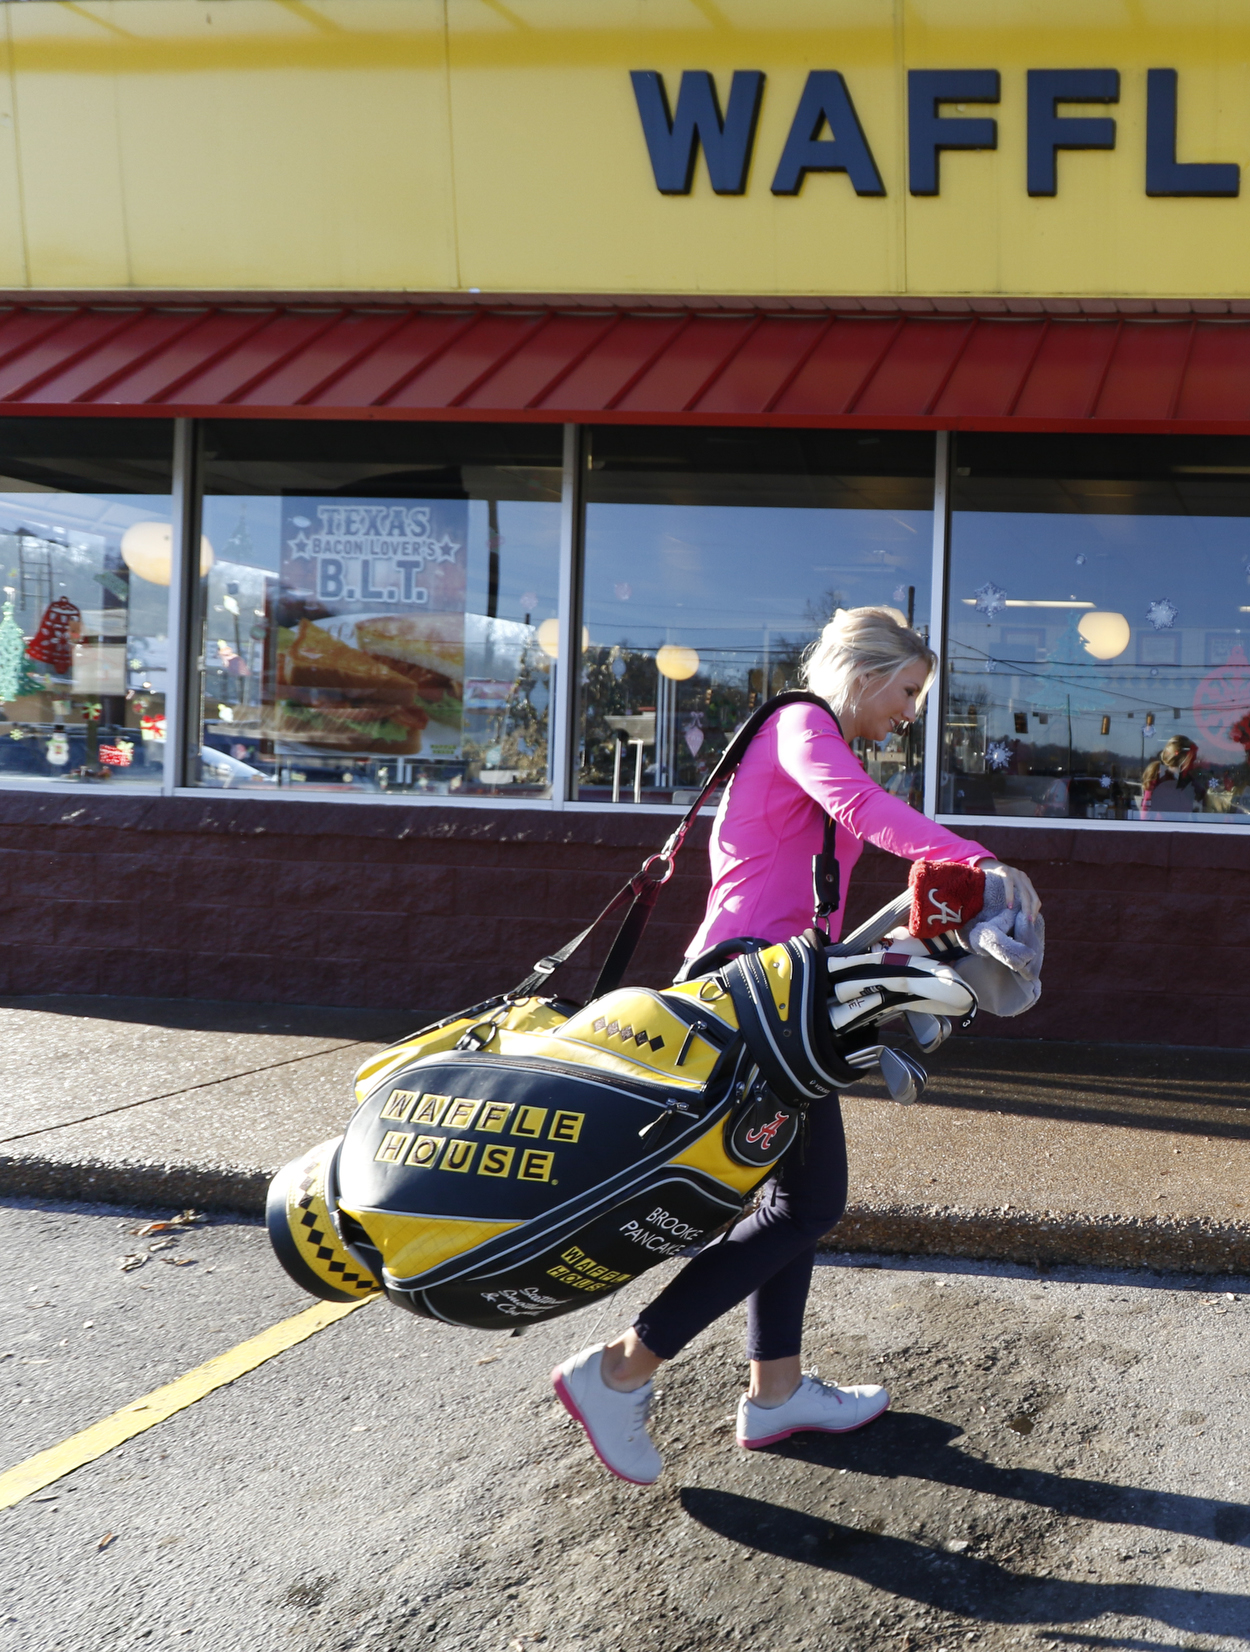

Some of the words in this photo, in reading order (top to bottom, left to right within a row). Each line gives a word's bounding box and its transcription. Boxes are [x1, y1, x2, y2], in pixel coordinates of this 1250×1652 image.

[317, 505, 431, 537] TEXAS
[312, 538, 364, 555] BACON
[369, 538, 436, 557] LOVER'S
[318, 557, 427, 602] B.L.T.
[383, 1090, 583, 1142] WAFFLE
[377, 1132, 552, 1181] HOUSE
[619, 1220, 686, 1256] PANCAKE
[646, 1207, 704, 1241] BROOKE
[547, 1265, 614, 1292] HOUS
[561, 1246, 636, 1282] WAFFL
